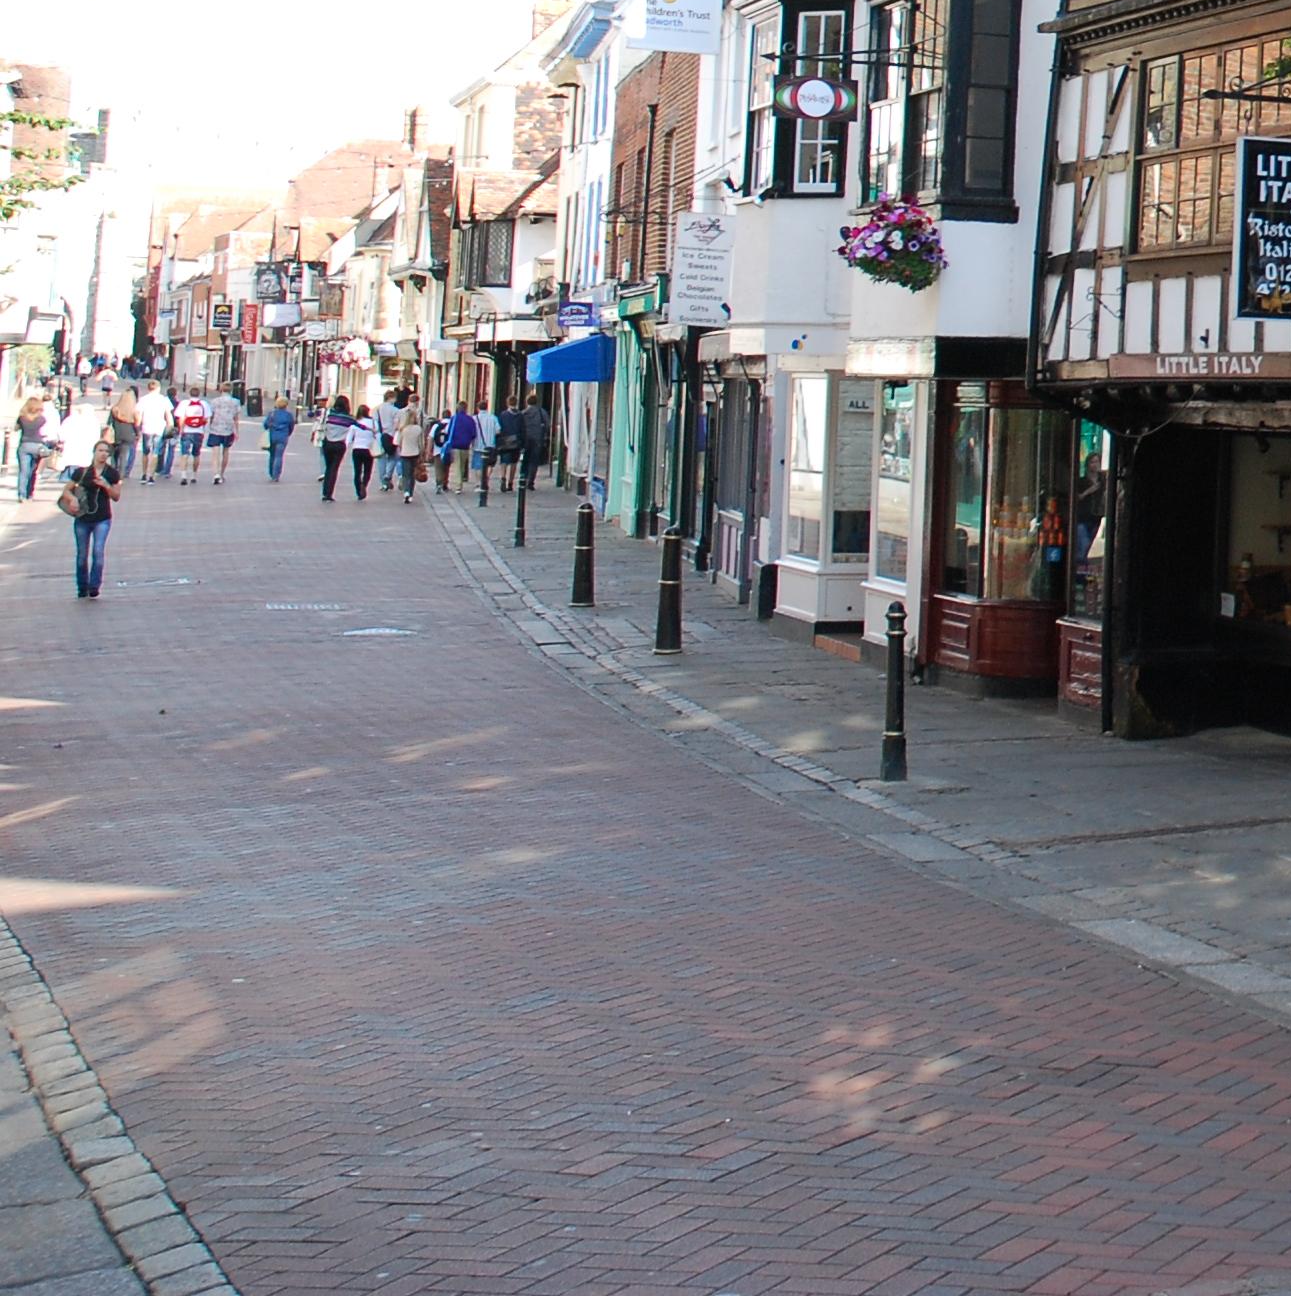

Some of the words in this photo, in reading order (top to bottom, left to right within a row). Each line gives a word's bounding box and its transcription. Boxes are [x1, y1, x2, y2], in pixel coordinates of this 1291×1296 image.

[646, 7, 684, 18] hildren's
[688, 9, 711, 20] Trust
[646, 17, 683, 27] adworth
[697, 253, 725, 261] Cream
[687, 263, 718, 271] Sweets
[700, 274, 724, 282] Drinks
[677, 292, 723, 301] Chocolates
[689, 305, 709, 313] Gifts
[1156, 356, 1208, 374] LITTLE
[1213, 356, 1263, 374] ITALY
[849, 400, 869, 409] ALL
